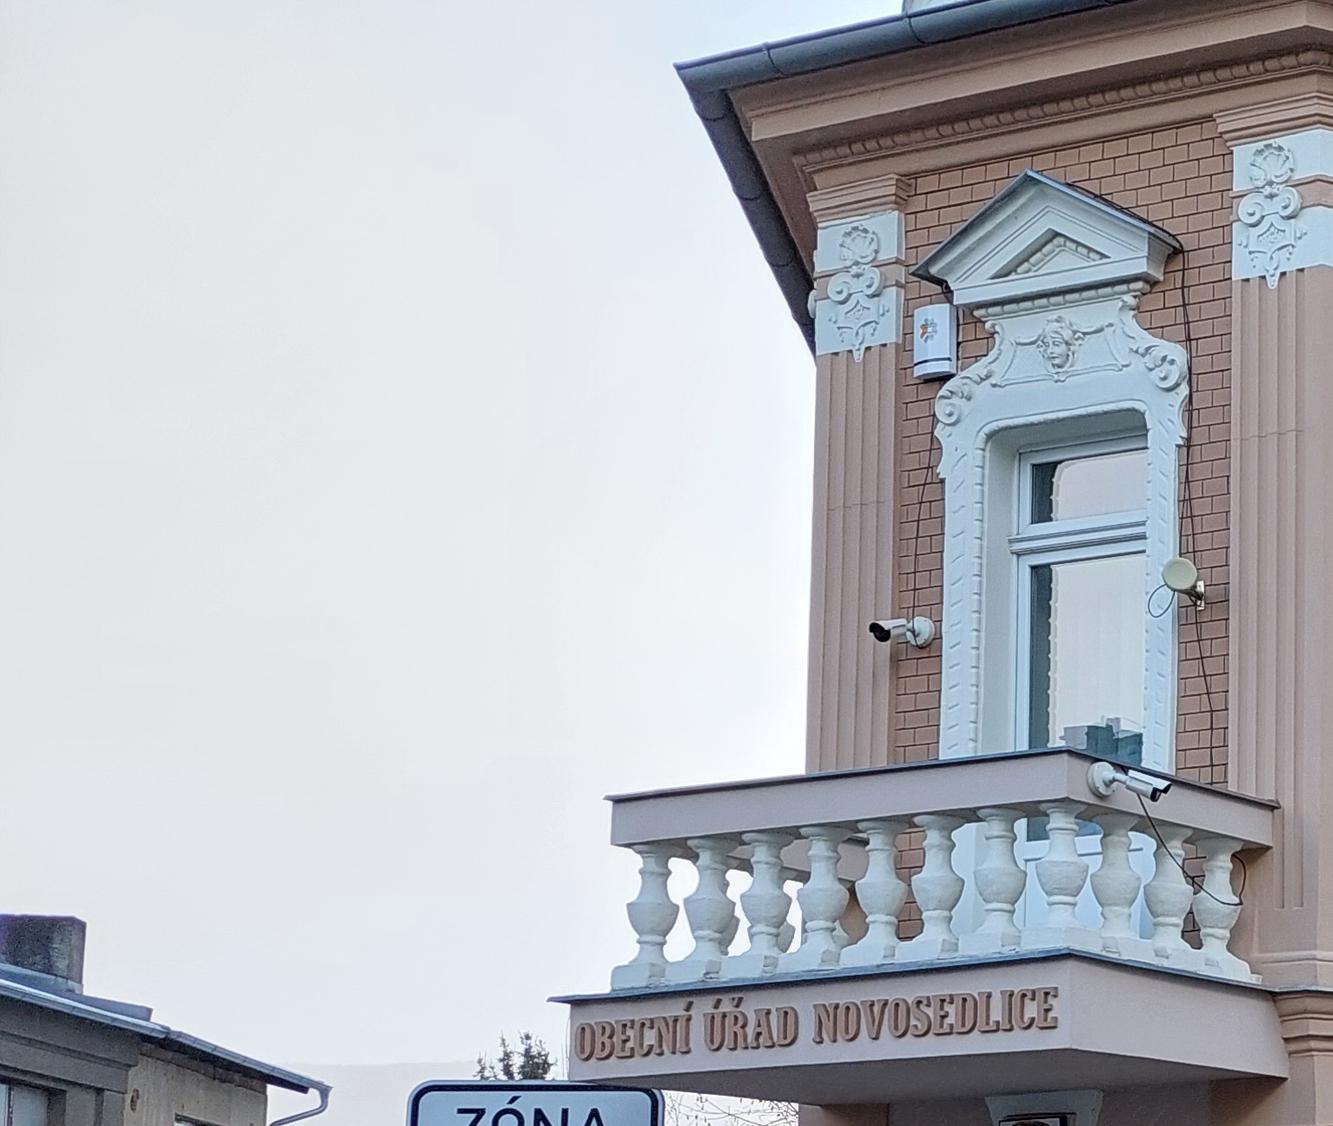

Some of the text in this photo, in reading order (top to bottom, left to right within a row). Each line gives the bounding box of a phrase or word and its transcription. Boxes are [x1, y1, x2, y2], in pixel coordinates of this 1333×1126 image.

[574, 987, 1059, 1061] OBECNÍ ÚŘAD NOVOSEDLICE
